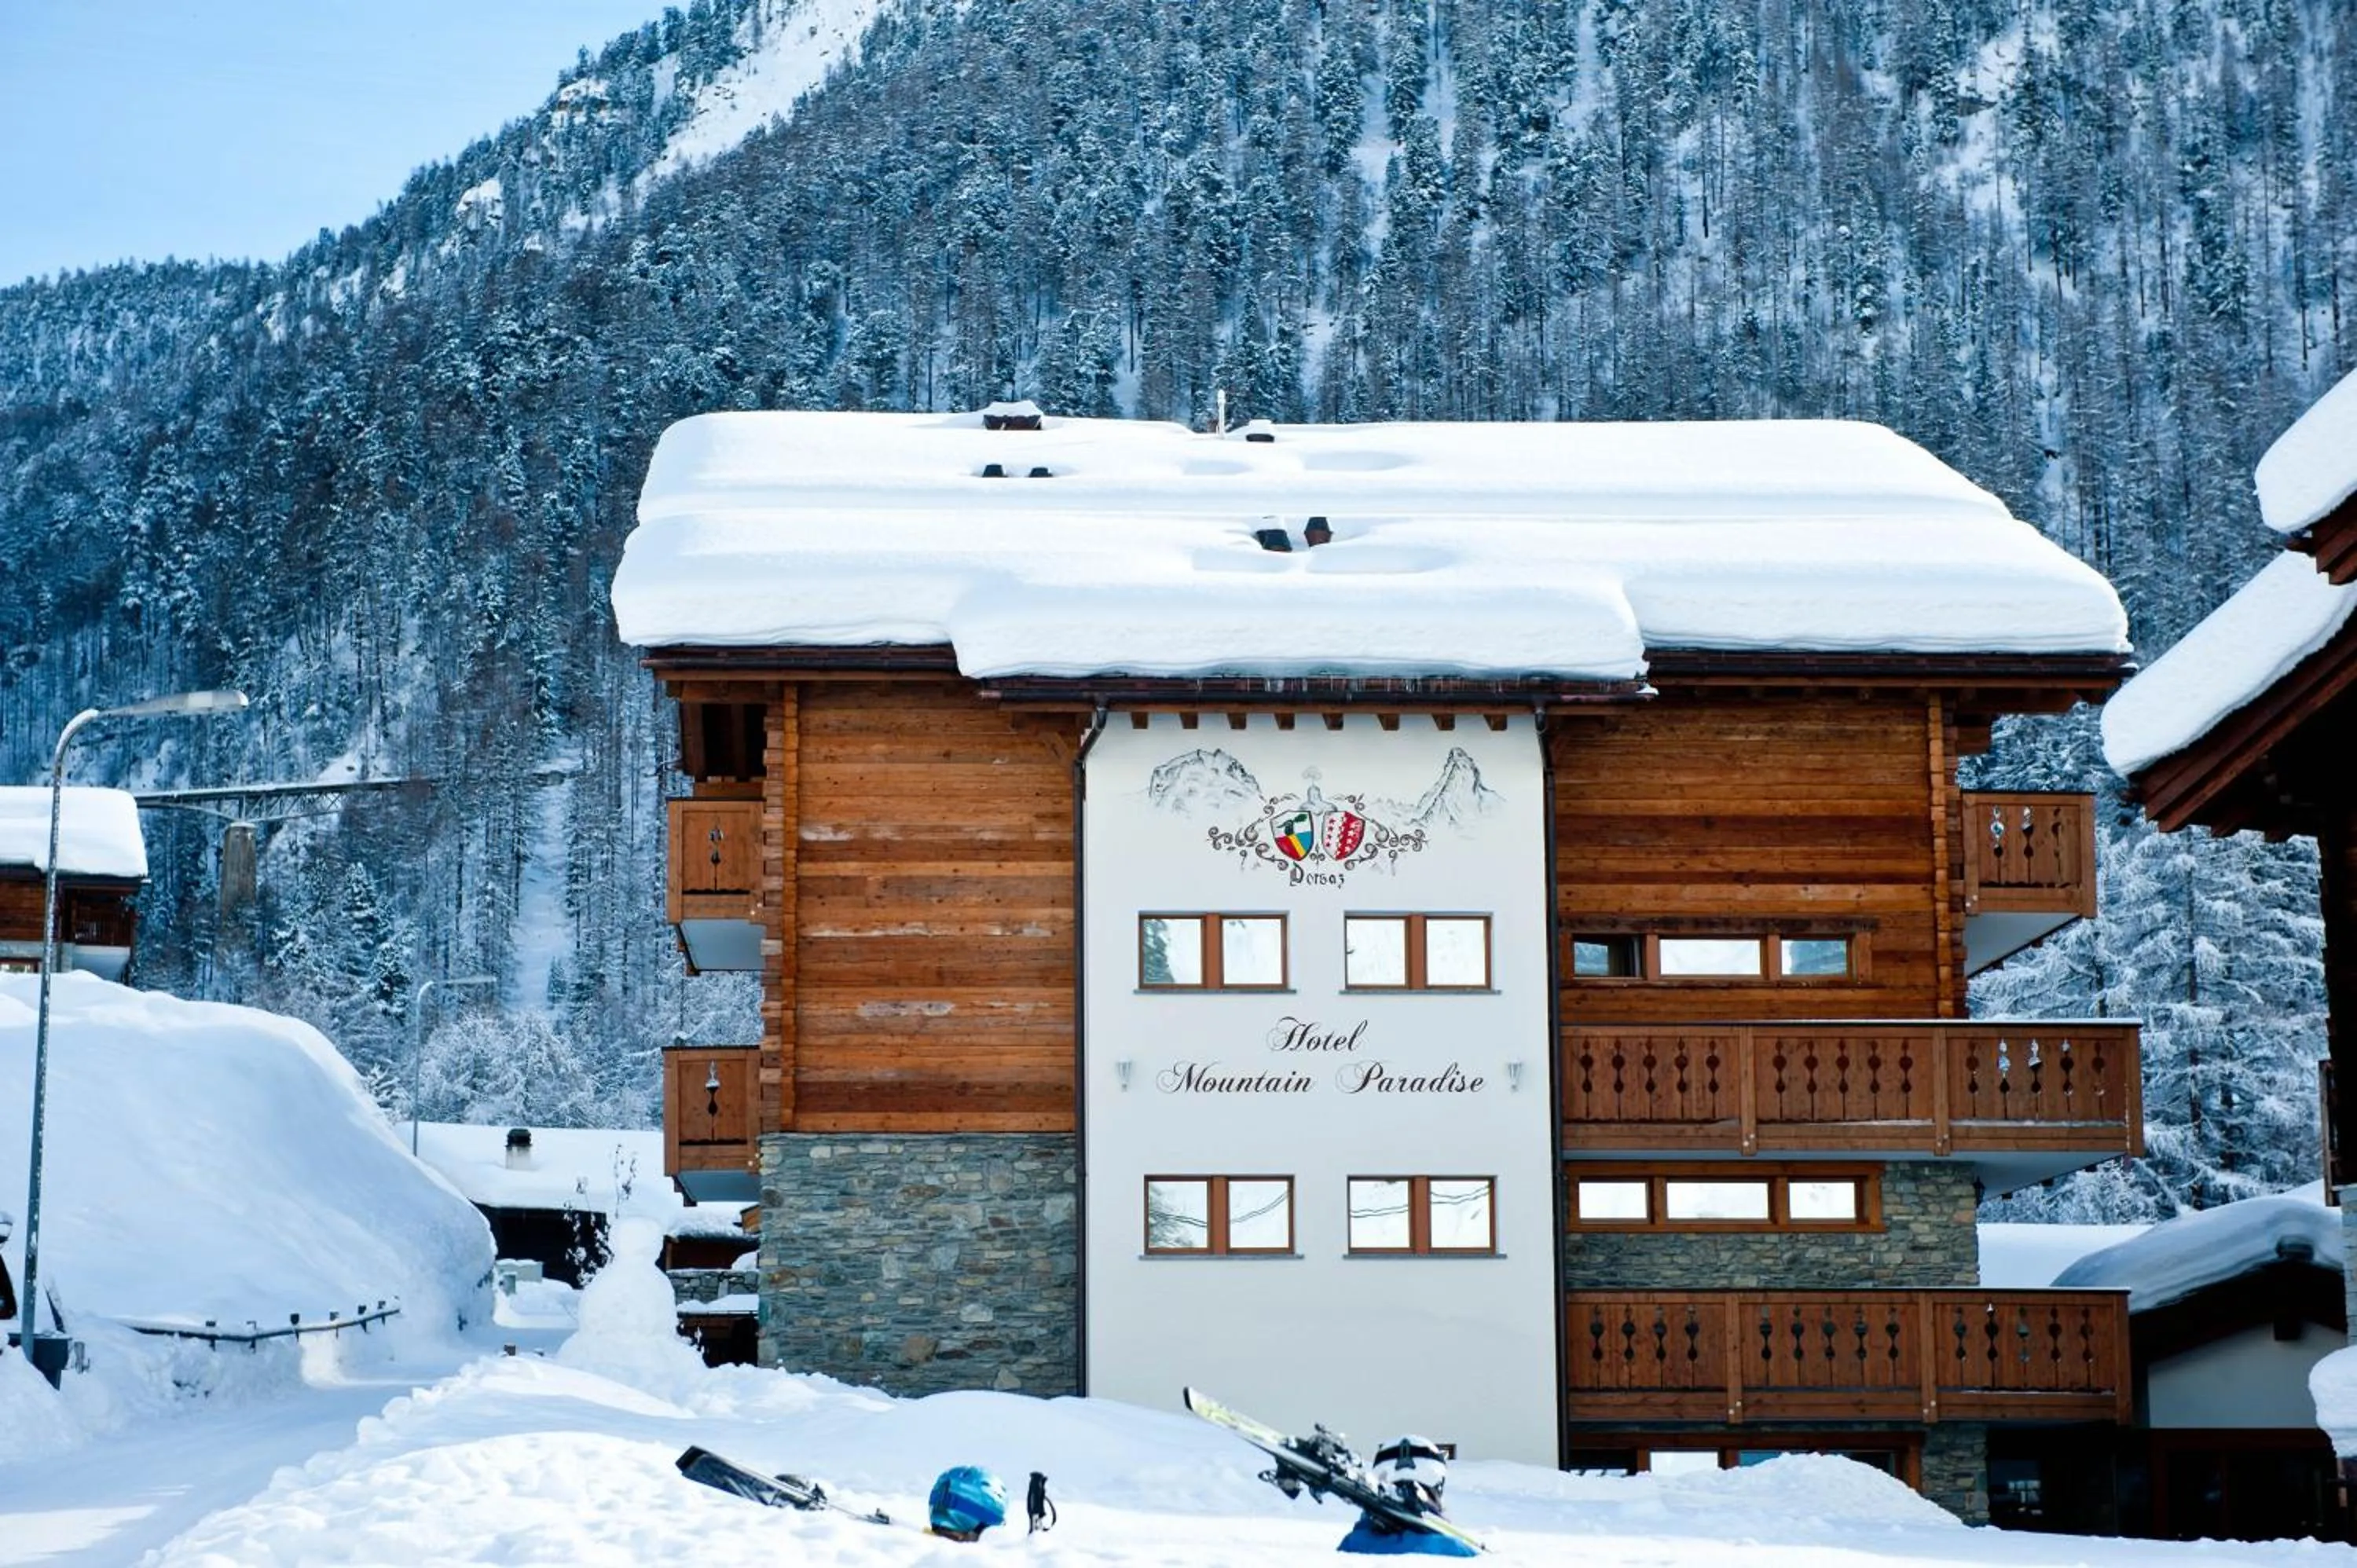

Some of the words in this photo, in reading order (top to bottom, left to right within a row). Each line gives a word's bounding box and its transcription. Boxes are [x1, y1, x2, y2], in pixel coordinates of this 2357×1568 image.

[1267, 1016, 1368, 1051] Hotel
[1157, 1061, 1313, 1094] Mountain
[1336, 1061, 1484, 1094] Paradise
